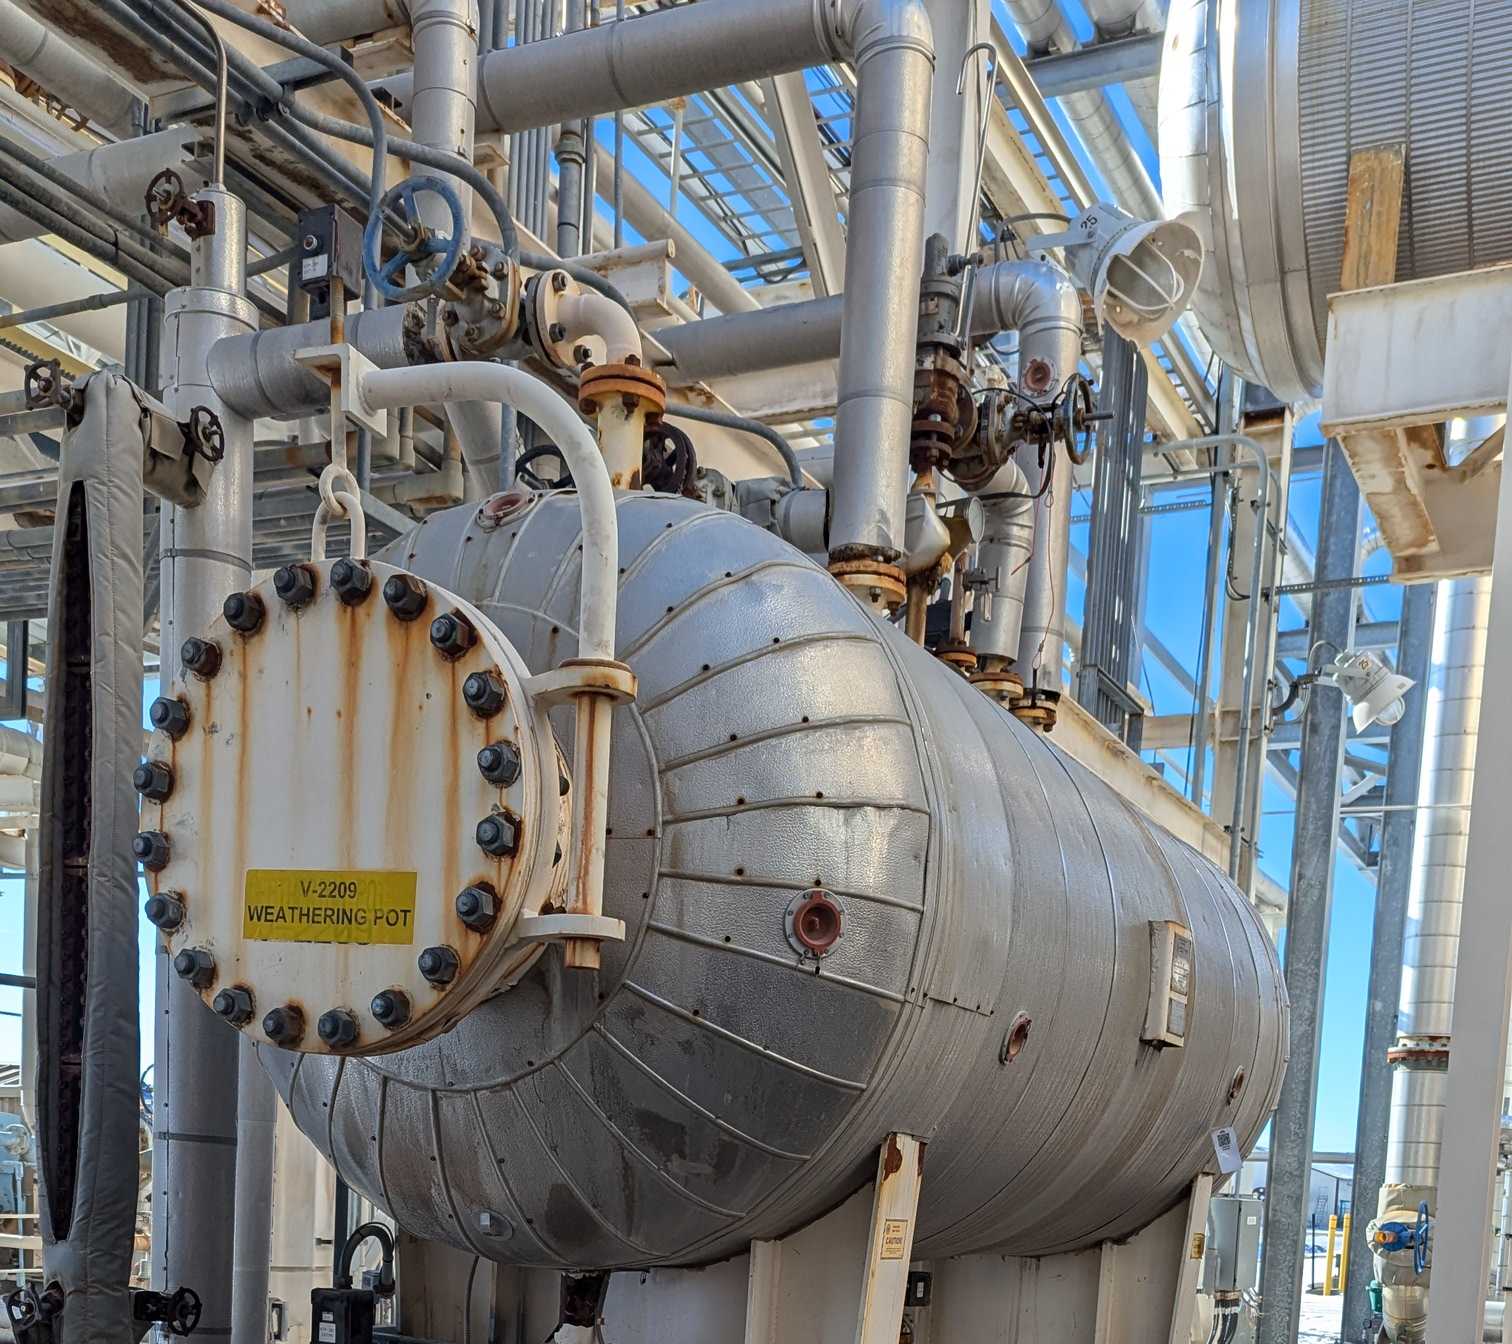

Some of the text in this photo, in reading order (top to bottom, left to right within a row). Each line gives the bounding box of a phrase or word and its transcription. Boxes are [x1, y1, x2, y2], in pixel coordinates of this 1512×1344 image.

[300, 880, 358, 899] V-2209
[247, 905, 412, 928] WEATHERING POT
